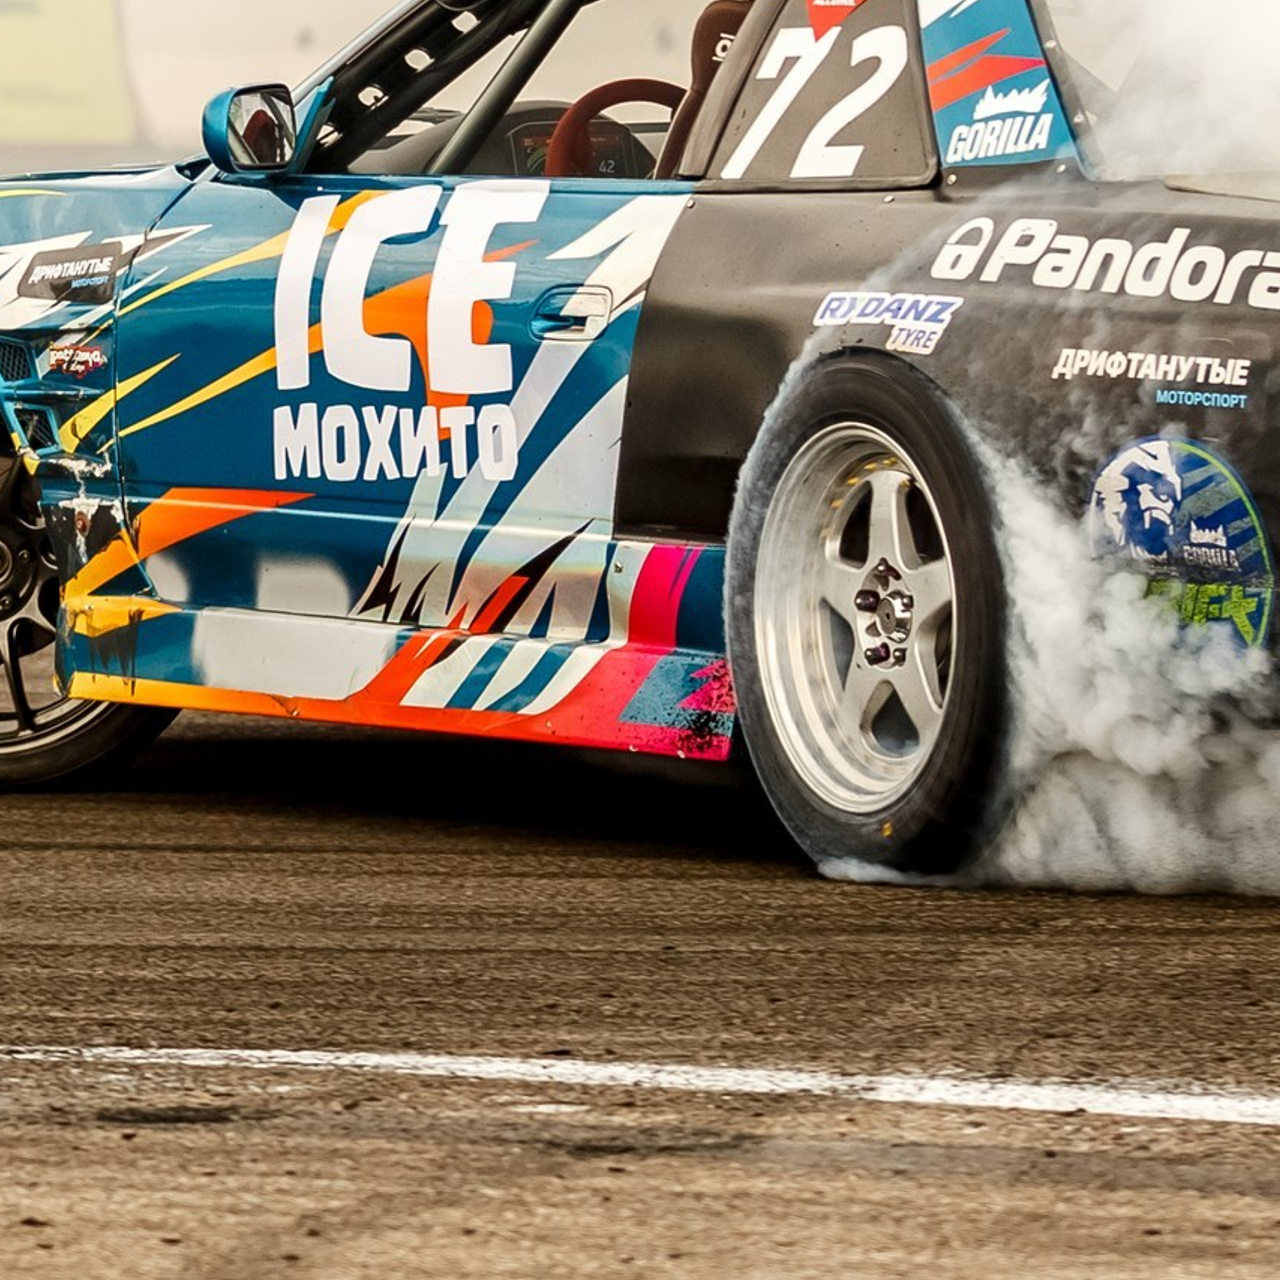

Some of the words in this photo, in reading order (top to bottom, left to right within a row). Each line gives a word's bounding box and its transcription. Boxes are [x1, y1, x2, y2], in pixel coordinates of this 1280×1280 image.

[720, 24, 909, 180] 72
[945, 113, 1054, 165] GORILLA
[273, 179, 552, 395] ICE
[891, 327, 938, 349] TYRE
[1052, 348, 1251, 386] ДРИФТАНУТЫЕ
[1156, 389, 1248, 409] МОТОРСПОРТ
[273, 403, 519, 482] МОХИТО
